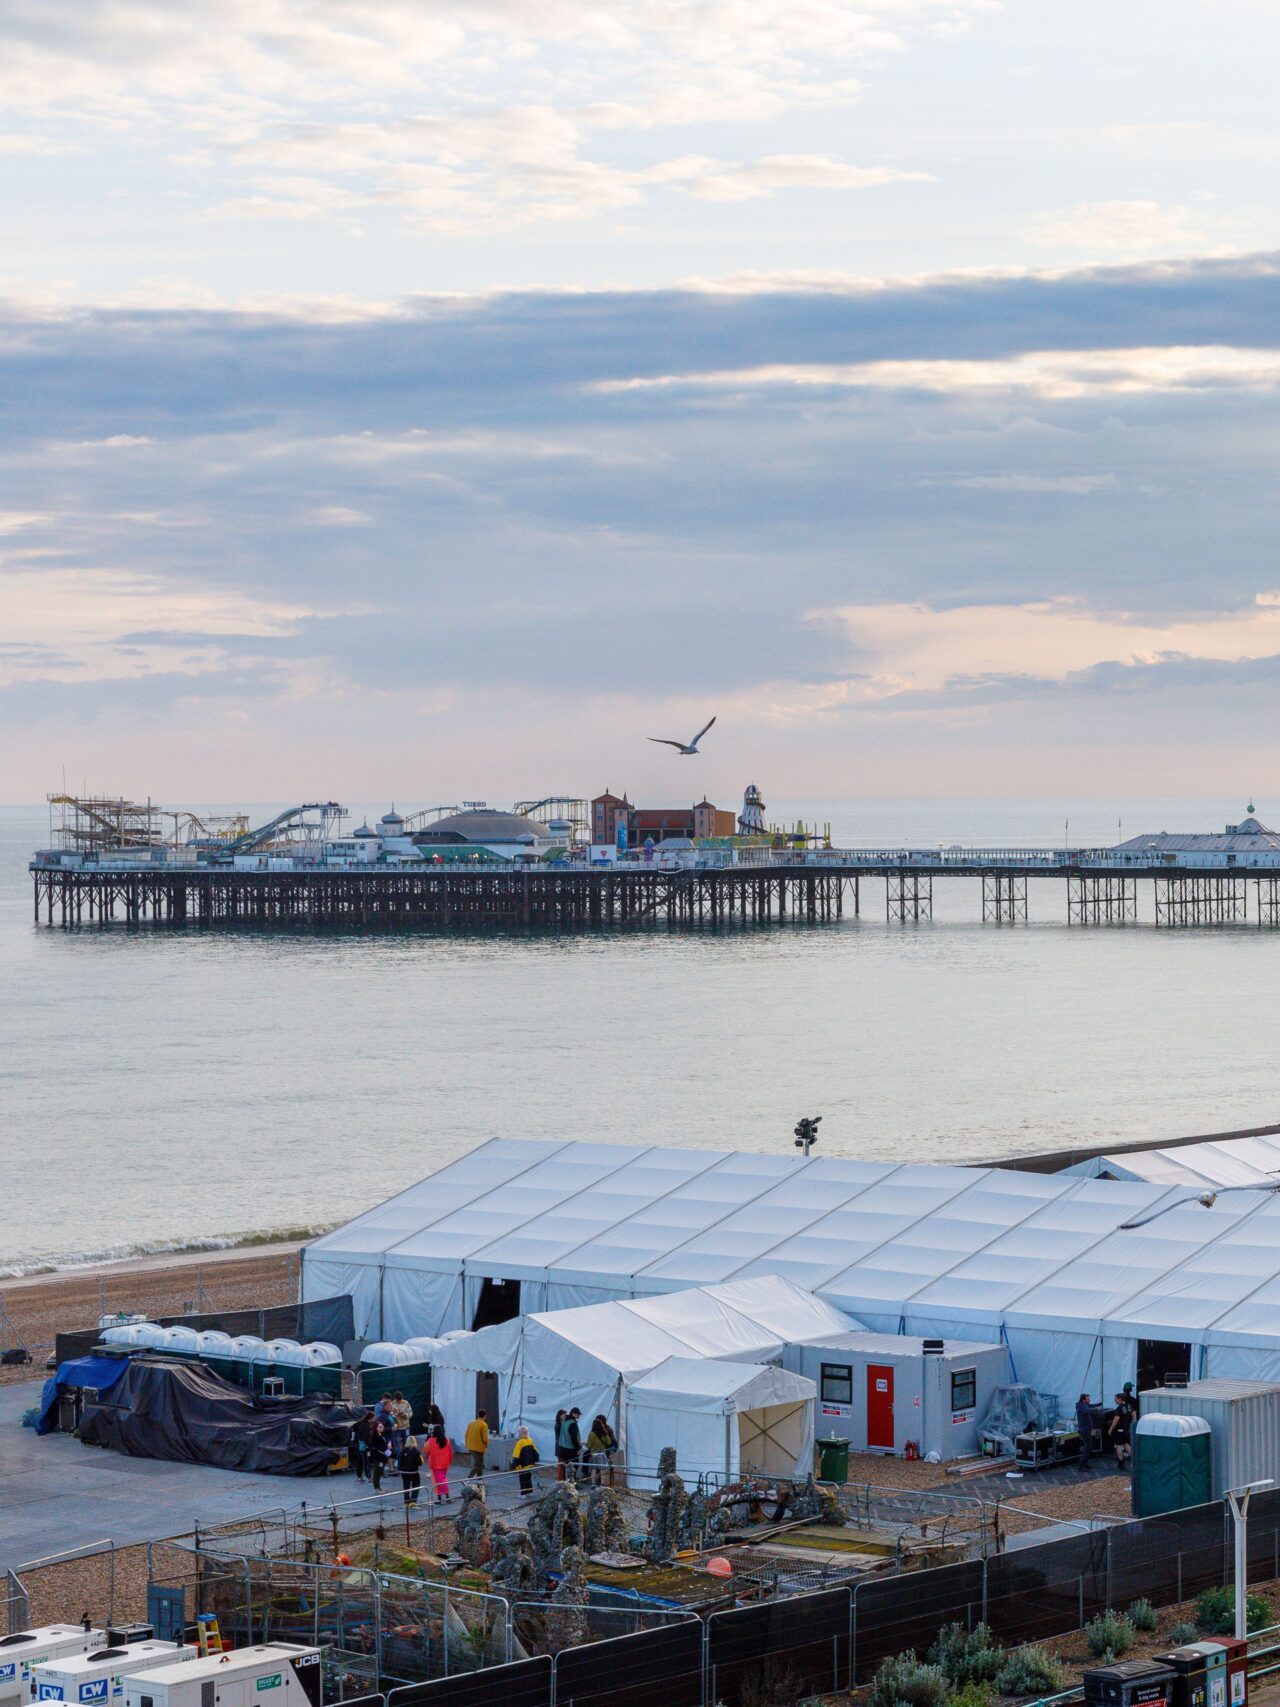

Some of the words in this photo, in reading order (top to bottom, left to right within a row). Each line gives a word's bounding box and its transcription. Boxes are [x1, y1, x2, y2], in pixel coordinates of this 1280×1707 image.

[295, 1654, 320, 1668] JCB
[42, 1685, 61, 1700] CW
[82, 1681, 105, 1700] CW
